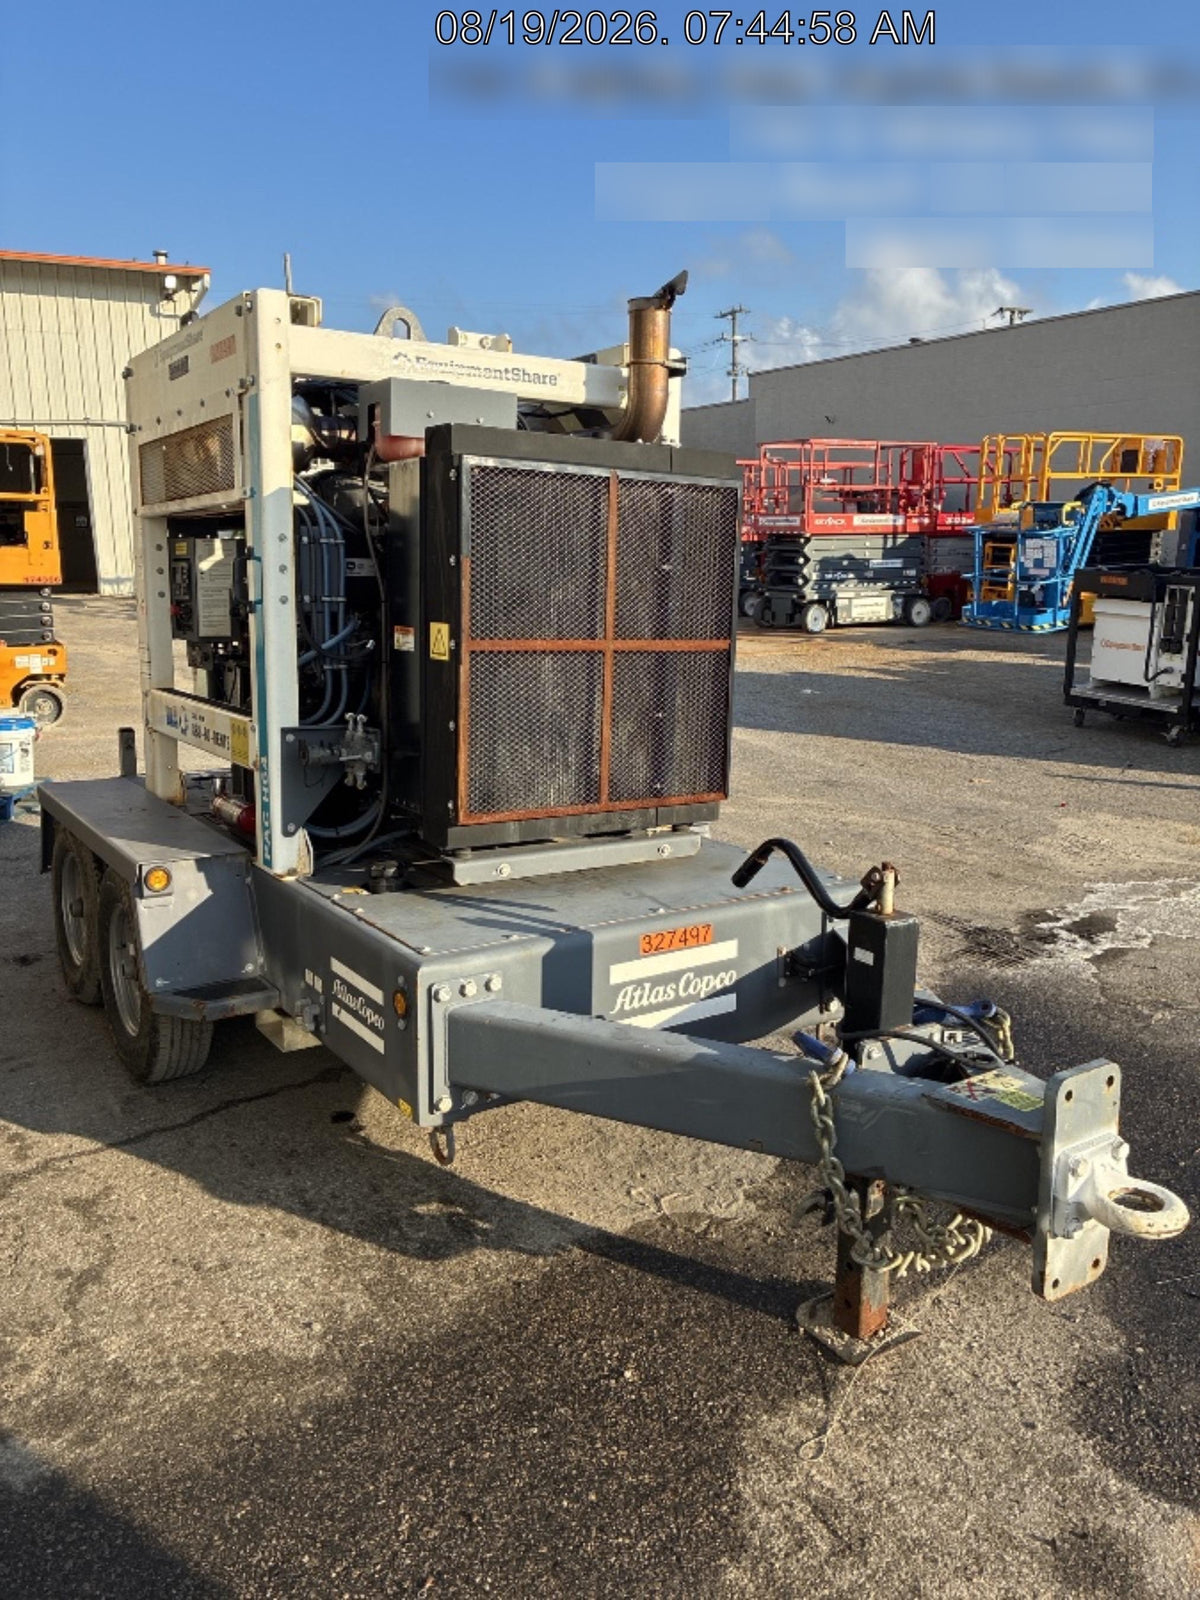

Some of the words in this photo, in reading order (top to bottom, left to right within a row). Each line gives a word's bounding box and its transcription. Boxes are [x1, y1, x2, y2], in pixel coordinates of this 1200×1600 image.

[642, 924, 711, 953] 327497
[332, 979, 358, 1010] Atlas
[357, 996, 385, 1030] Copco
[610, 981, 676, 1014] Atlas
[677, 969, 737, 998] Copco
